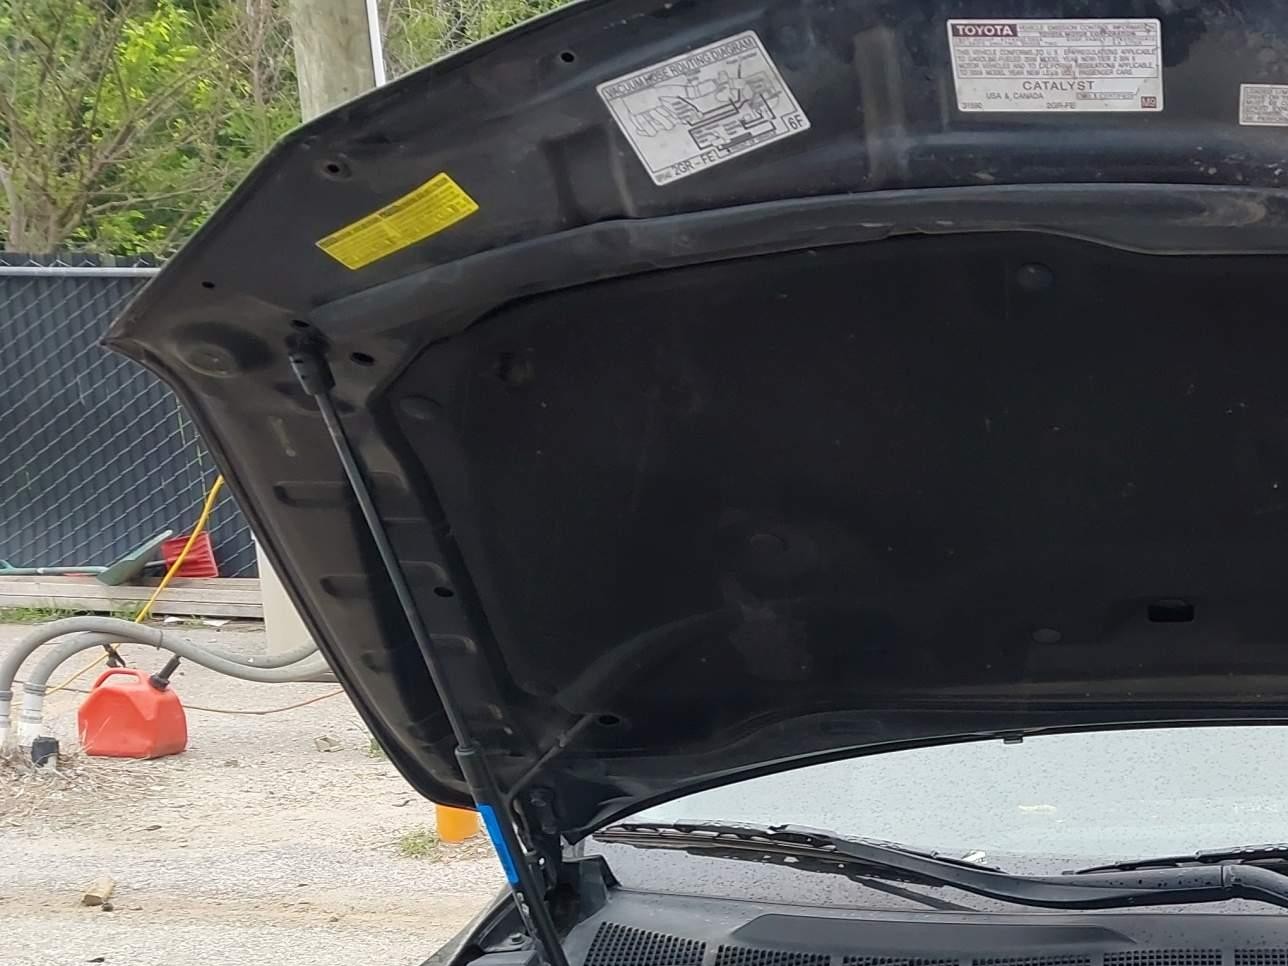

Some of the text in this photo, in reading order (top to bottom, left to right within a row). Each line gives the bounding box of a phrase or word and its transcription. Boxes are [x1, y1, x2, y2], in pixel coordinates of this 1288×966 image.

[957, 25, 1014, 36] TOYOTA
[604, 78, 648, 98] VACUUM
[644, 69, 670, 86] HOSE
[670, 56, 713, 77] ROUTING
[710, 38, 755, 61] DIAGRAM
[1022, 80, 1095, 90] CATALYST
[985, 92, 1002, 100] USA
[1012, 92, 1045, 100] CANADA
